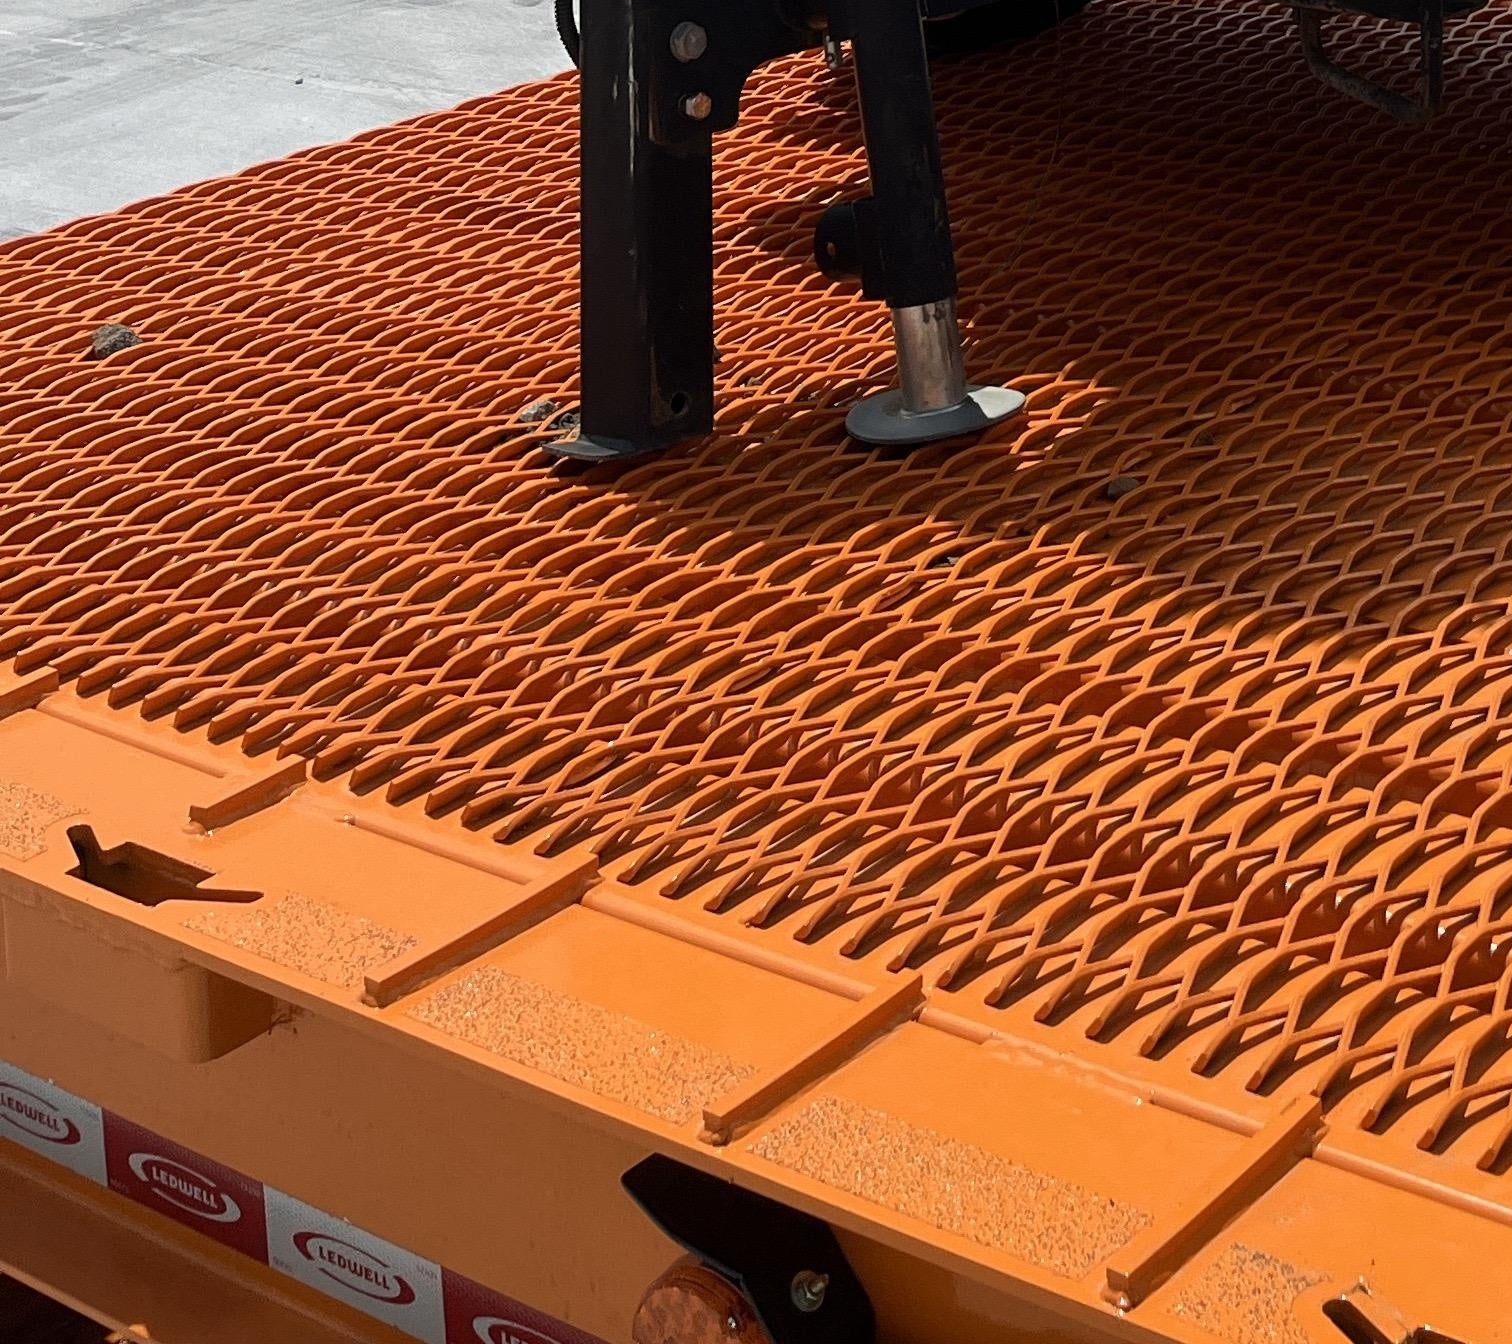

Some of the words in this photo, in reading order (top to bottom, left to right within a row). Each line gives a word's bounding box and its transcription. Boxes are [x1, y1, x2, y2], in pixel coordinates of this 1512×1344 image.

[0, 1091, 61, 1133] LEDWELL
[151, 1165, 219, 1209] LEDWELL
[317, 1244, 391, 1291] LEDWELL
